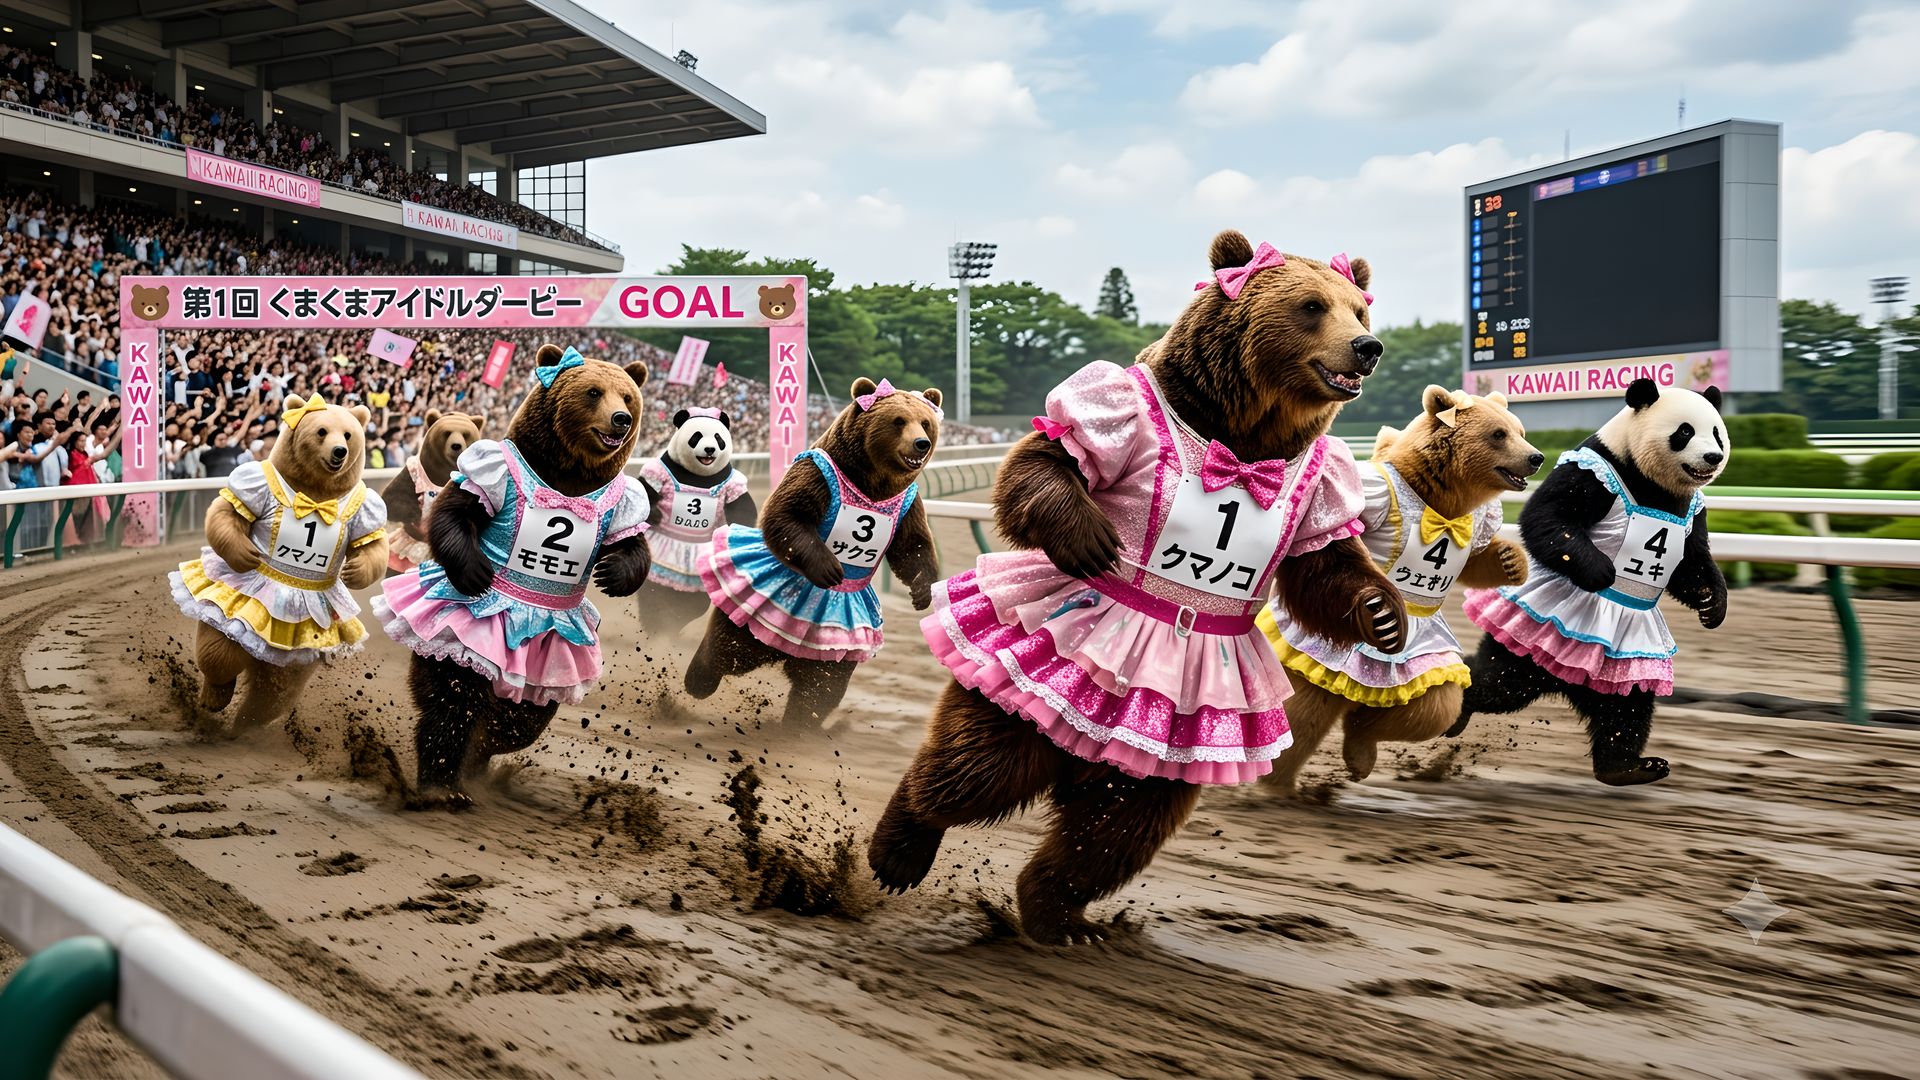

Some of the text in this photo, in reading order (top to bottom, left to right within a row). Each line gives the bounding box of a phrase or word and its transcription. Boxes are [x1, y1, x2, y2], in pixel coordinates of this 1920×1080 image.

[259, 173, 307, 199] RACING
[183, 286, 582, 320] 第1回 くまくまアイドルダービー
[619, 285, 744, 319] GOAL
[1508, 363, 1674, 395] KAWAII RACING
[127, 344, 151, 466] KAWAII
[304, 521, 317, 548] 1
[541, 516, 574, 553] 2
[852, 514, 876, 542] 3
[1216, 500, 1240, 551] 1
[277, 544, 329, 568] クマノコ
[1423, 537, 1450, 570] 4
[1643, 527, 1669, 559] 4
[517, 548, 580, 577] モモエ
[1161, 543, 1257, 592] クマノコ
[1623, 557, 1665, 581] ユキ
